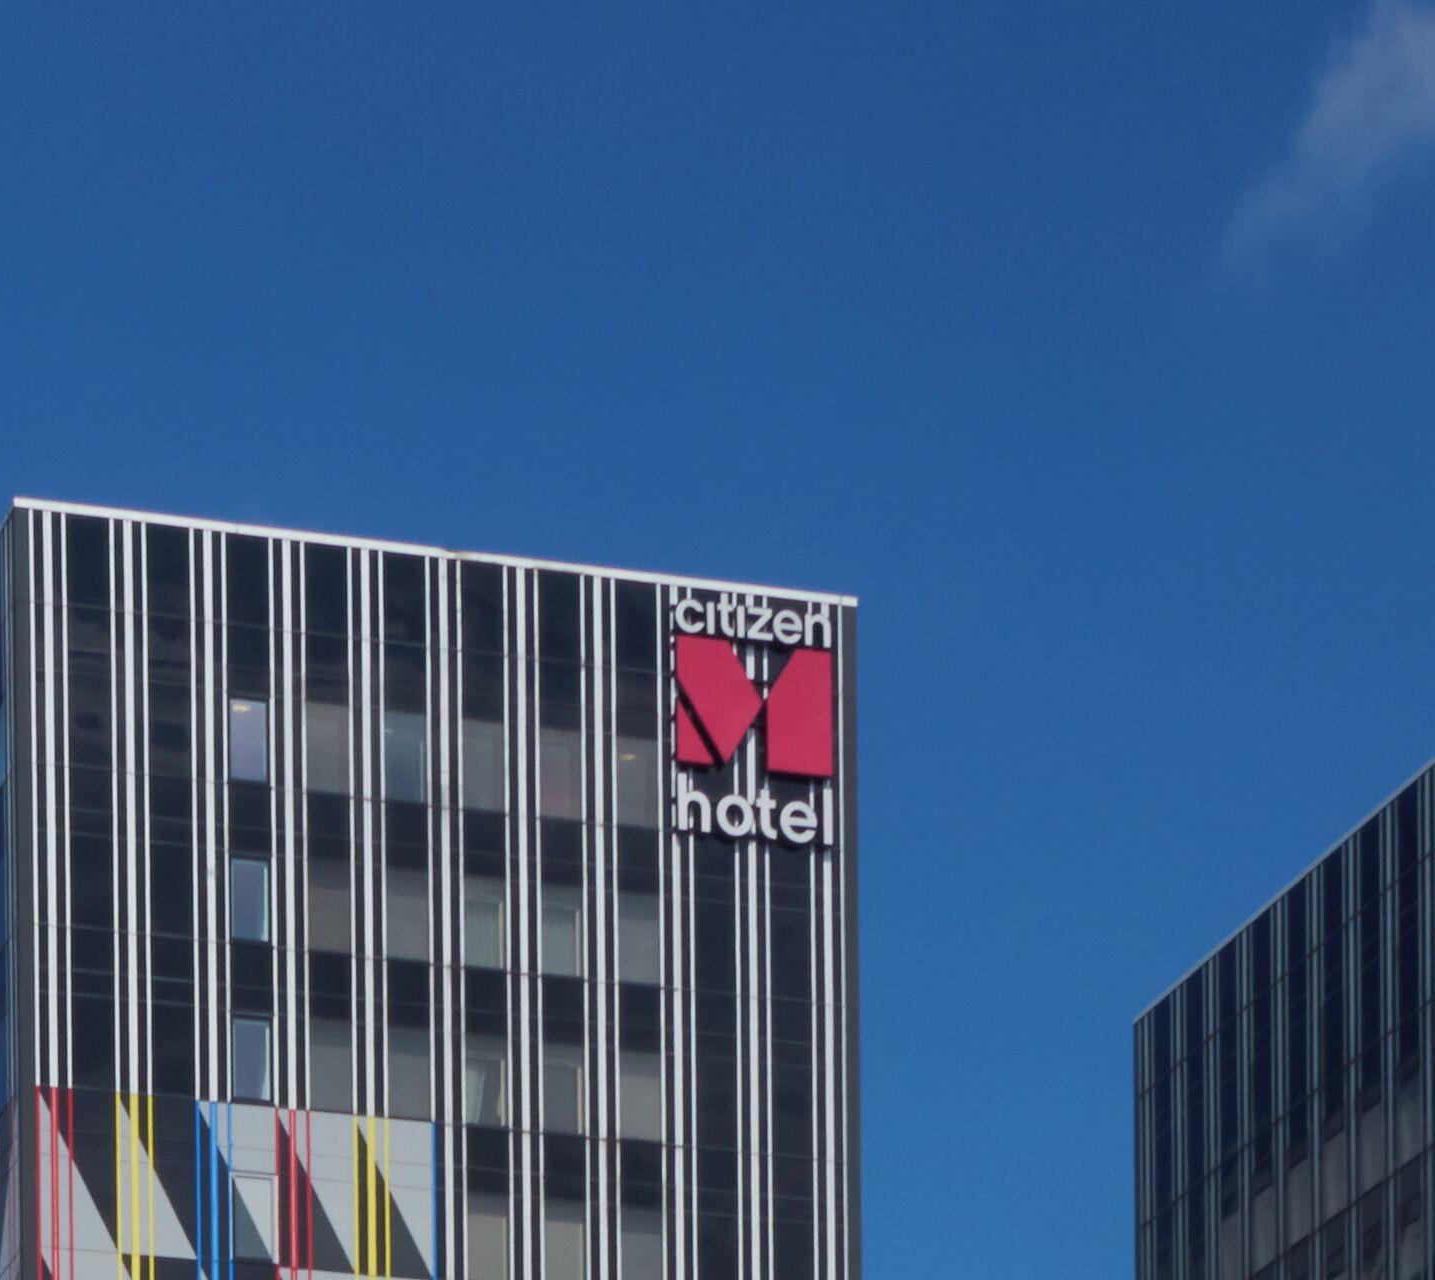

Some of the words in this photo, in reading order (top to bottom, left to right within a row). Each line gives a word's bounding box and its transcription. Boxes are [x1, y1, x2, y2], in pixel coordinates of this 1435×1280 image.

[674, 592, 832, 648] citizen
[675, 634, 834, 778] M
[677, 771, 834, 846] hotel
